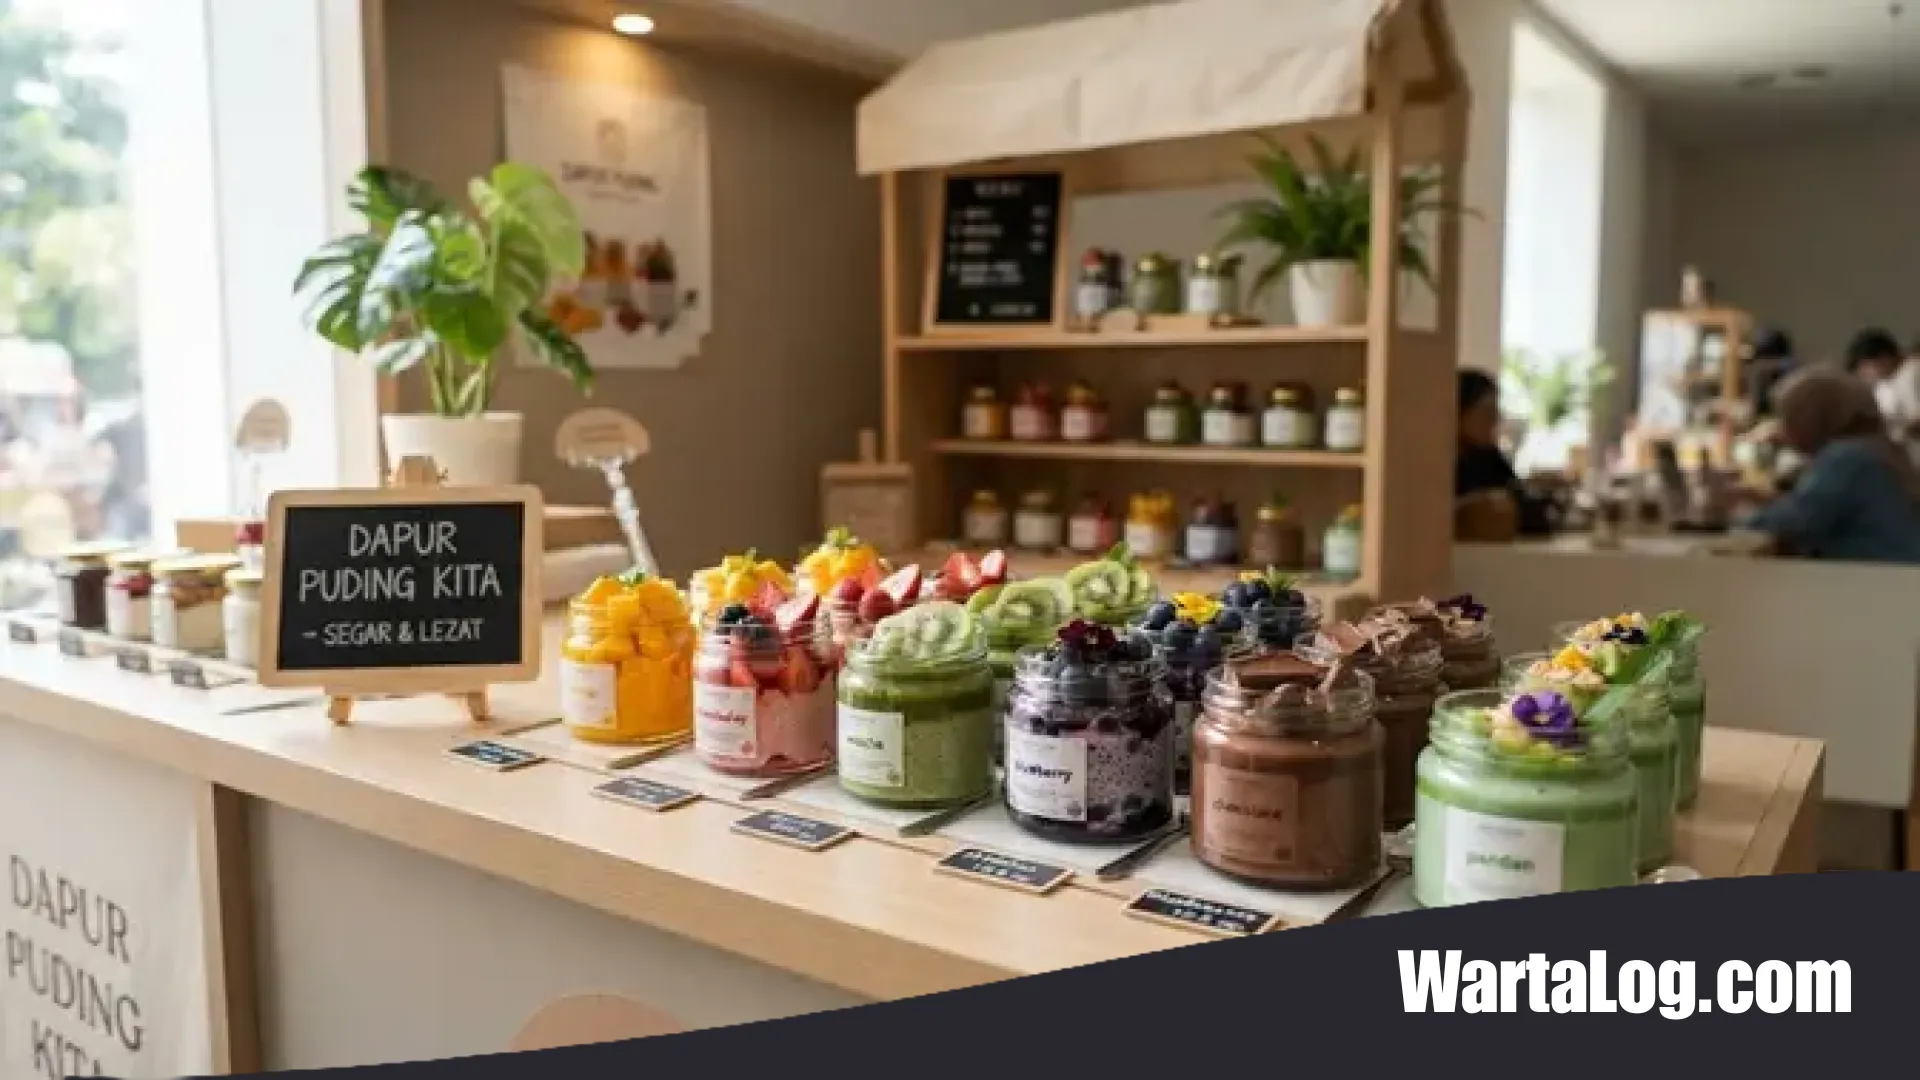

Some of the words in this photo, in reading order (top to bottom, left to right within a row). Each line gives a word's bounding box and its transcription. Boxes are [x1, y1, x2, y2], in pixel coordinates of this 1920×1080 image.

[348, 520, 458, 557] DAPUR
[299, 566, 415, 602] PUDING
[432, 563, 502, 599] KITA
[322, 621, 392, 647] SEGAR
[398, 620, 413, 643] &
[418, 618, 484, 643] LEZAT
[9, 853, 131, 964] DAPUR
[6, 929, 144, 1051] PUDING
